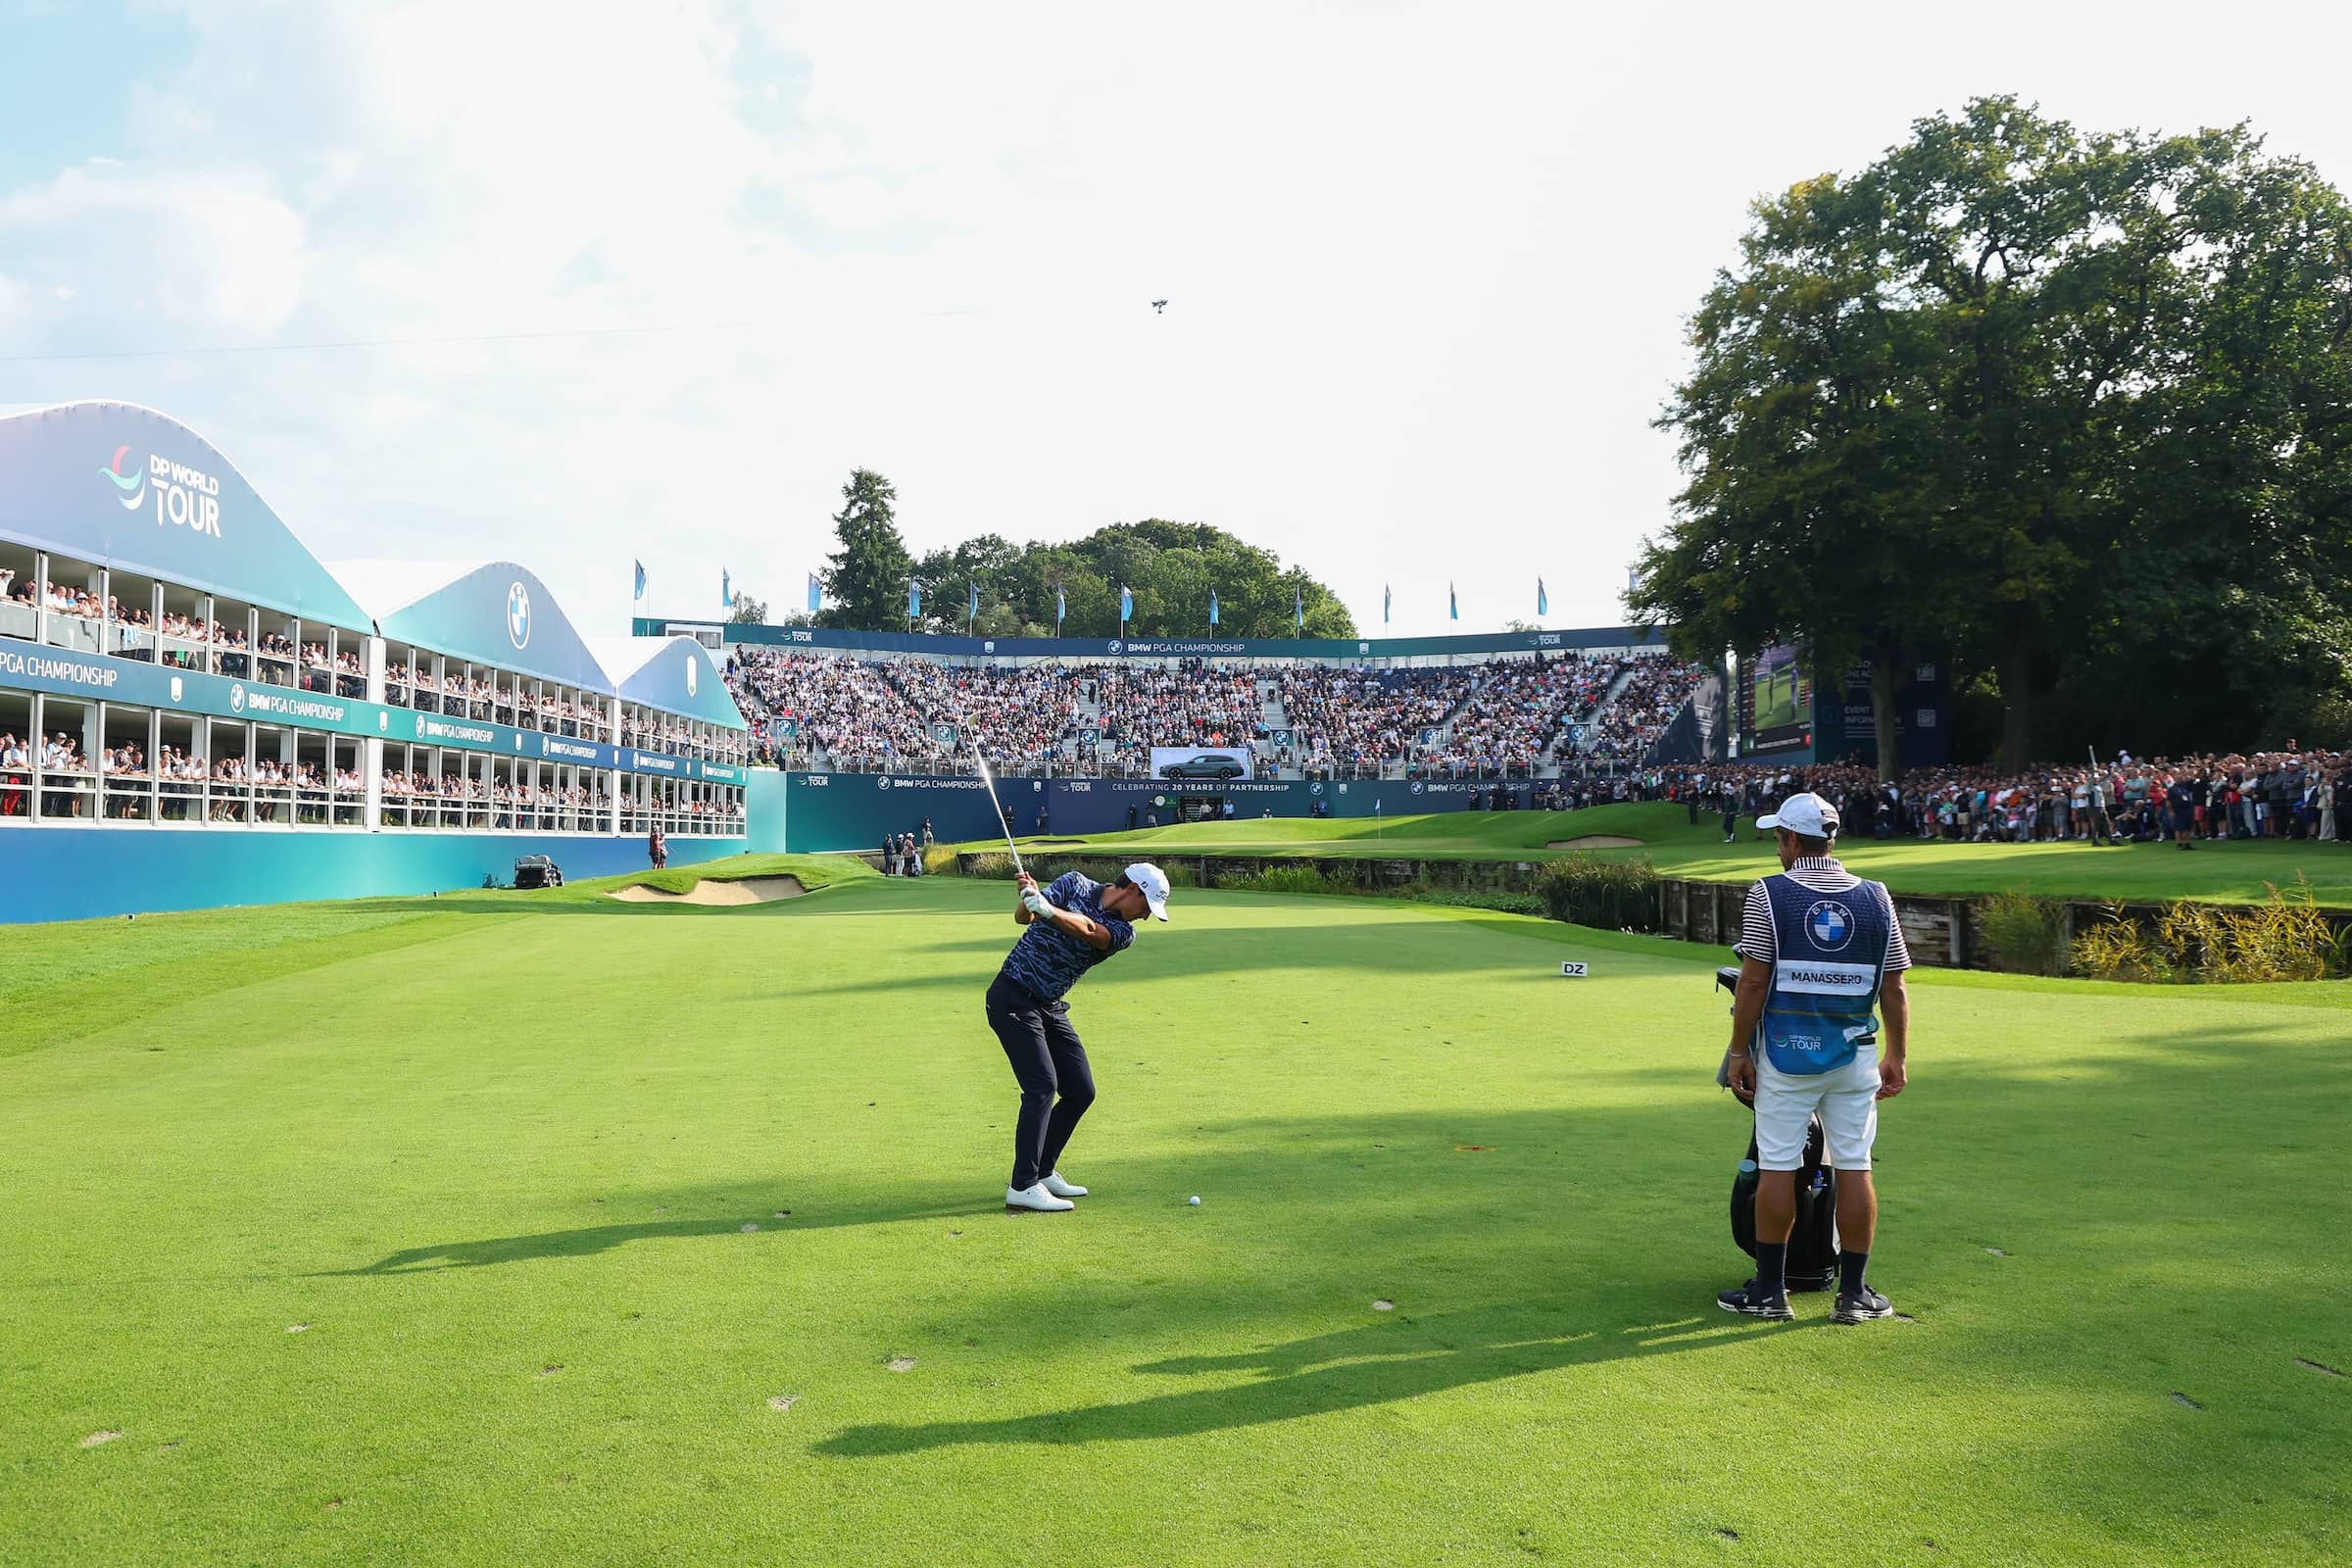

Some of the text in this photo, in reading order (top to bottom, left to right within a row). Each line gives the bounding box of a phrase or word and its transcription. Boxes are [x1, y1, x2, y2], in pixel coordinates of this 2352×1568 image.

[150, 454, 220, 496] DP WORLD
[151, 477, 221, 538] TOUR
[791, 634, 813, 643] TOUR
[1539, 637, 1561, 647] TOUR
[1127, 643, 1246, 653] BMW PGA CHAMPIONSHIP
[0, 652, 118, 687] PGA CHAMPIONSHIP
[248, 693, 345, 722] BMW PGA CHAMPIONSHIP
[426, 721, 494, 743] BMW PGA CHAMPIONSHIP
[894, 779, 988, 790] BMW PGA CHAMPIONSHIP
[1069, 784, 1092, 793] TOUR
[1111, 783, 1170, 792] CELEBRATING
[1171, 783, 1183, 792] 20
[1185, 783, 1214, 792] YEARS
[1215, 783, 1227, 792] OF
[1449, 783, 1467, 792] PGA
[1811, 903, 1848, 918] BMW
[1564, 963, 1585, 974] DZ
[1791, 970, 1862, 985] MANASSERO
[1789, 1040, 1821, 1051] TOUR
